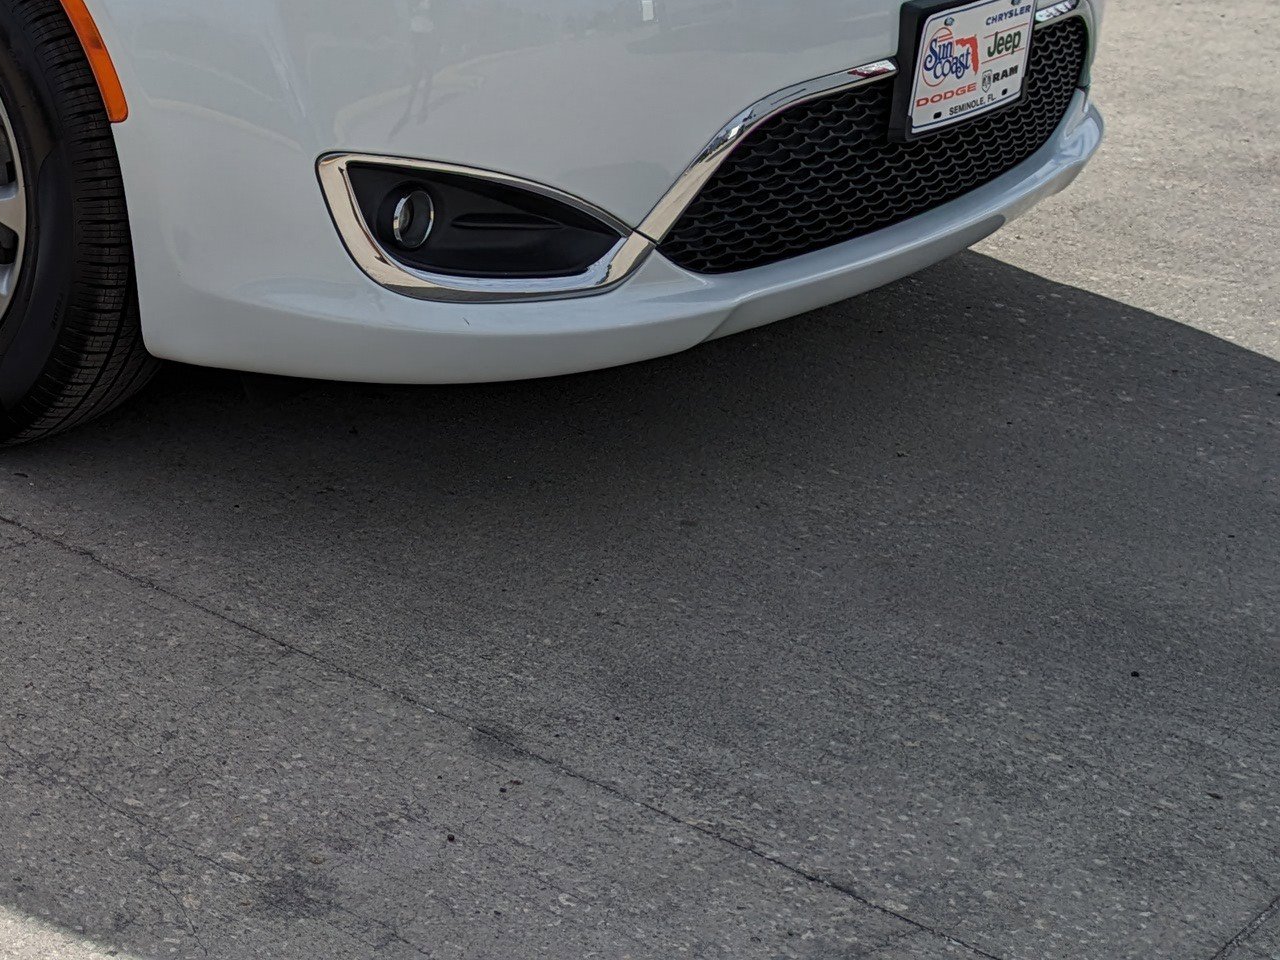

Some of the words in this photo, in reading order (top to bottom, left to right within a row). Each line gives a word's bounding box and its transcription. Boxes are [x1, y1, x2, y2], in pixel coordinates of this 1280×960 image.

[985, 4, 1032, 26] CHRYSLER
[923, 37, 954, 71] Sun
[987, 30, 1022, 56] Jeep
[992, 64, 1019, 83] RAM
[916, 82, 977, 108] DODGE
